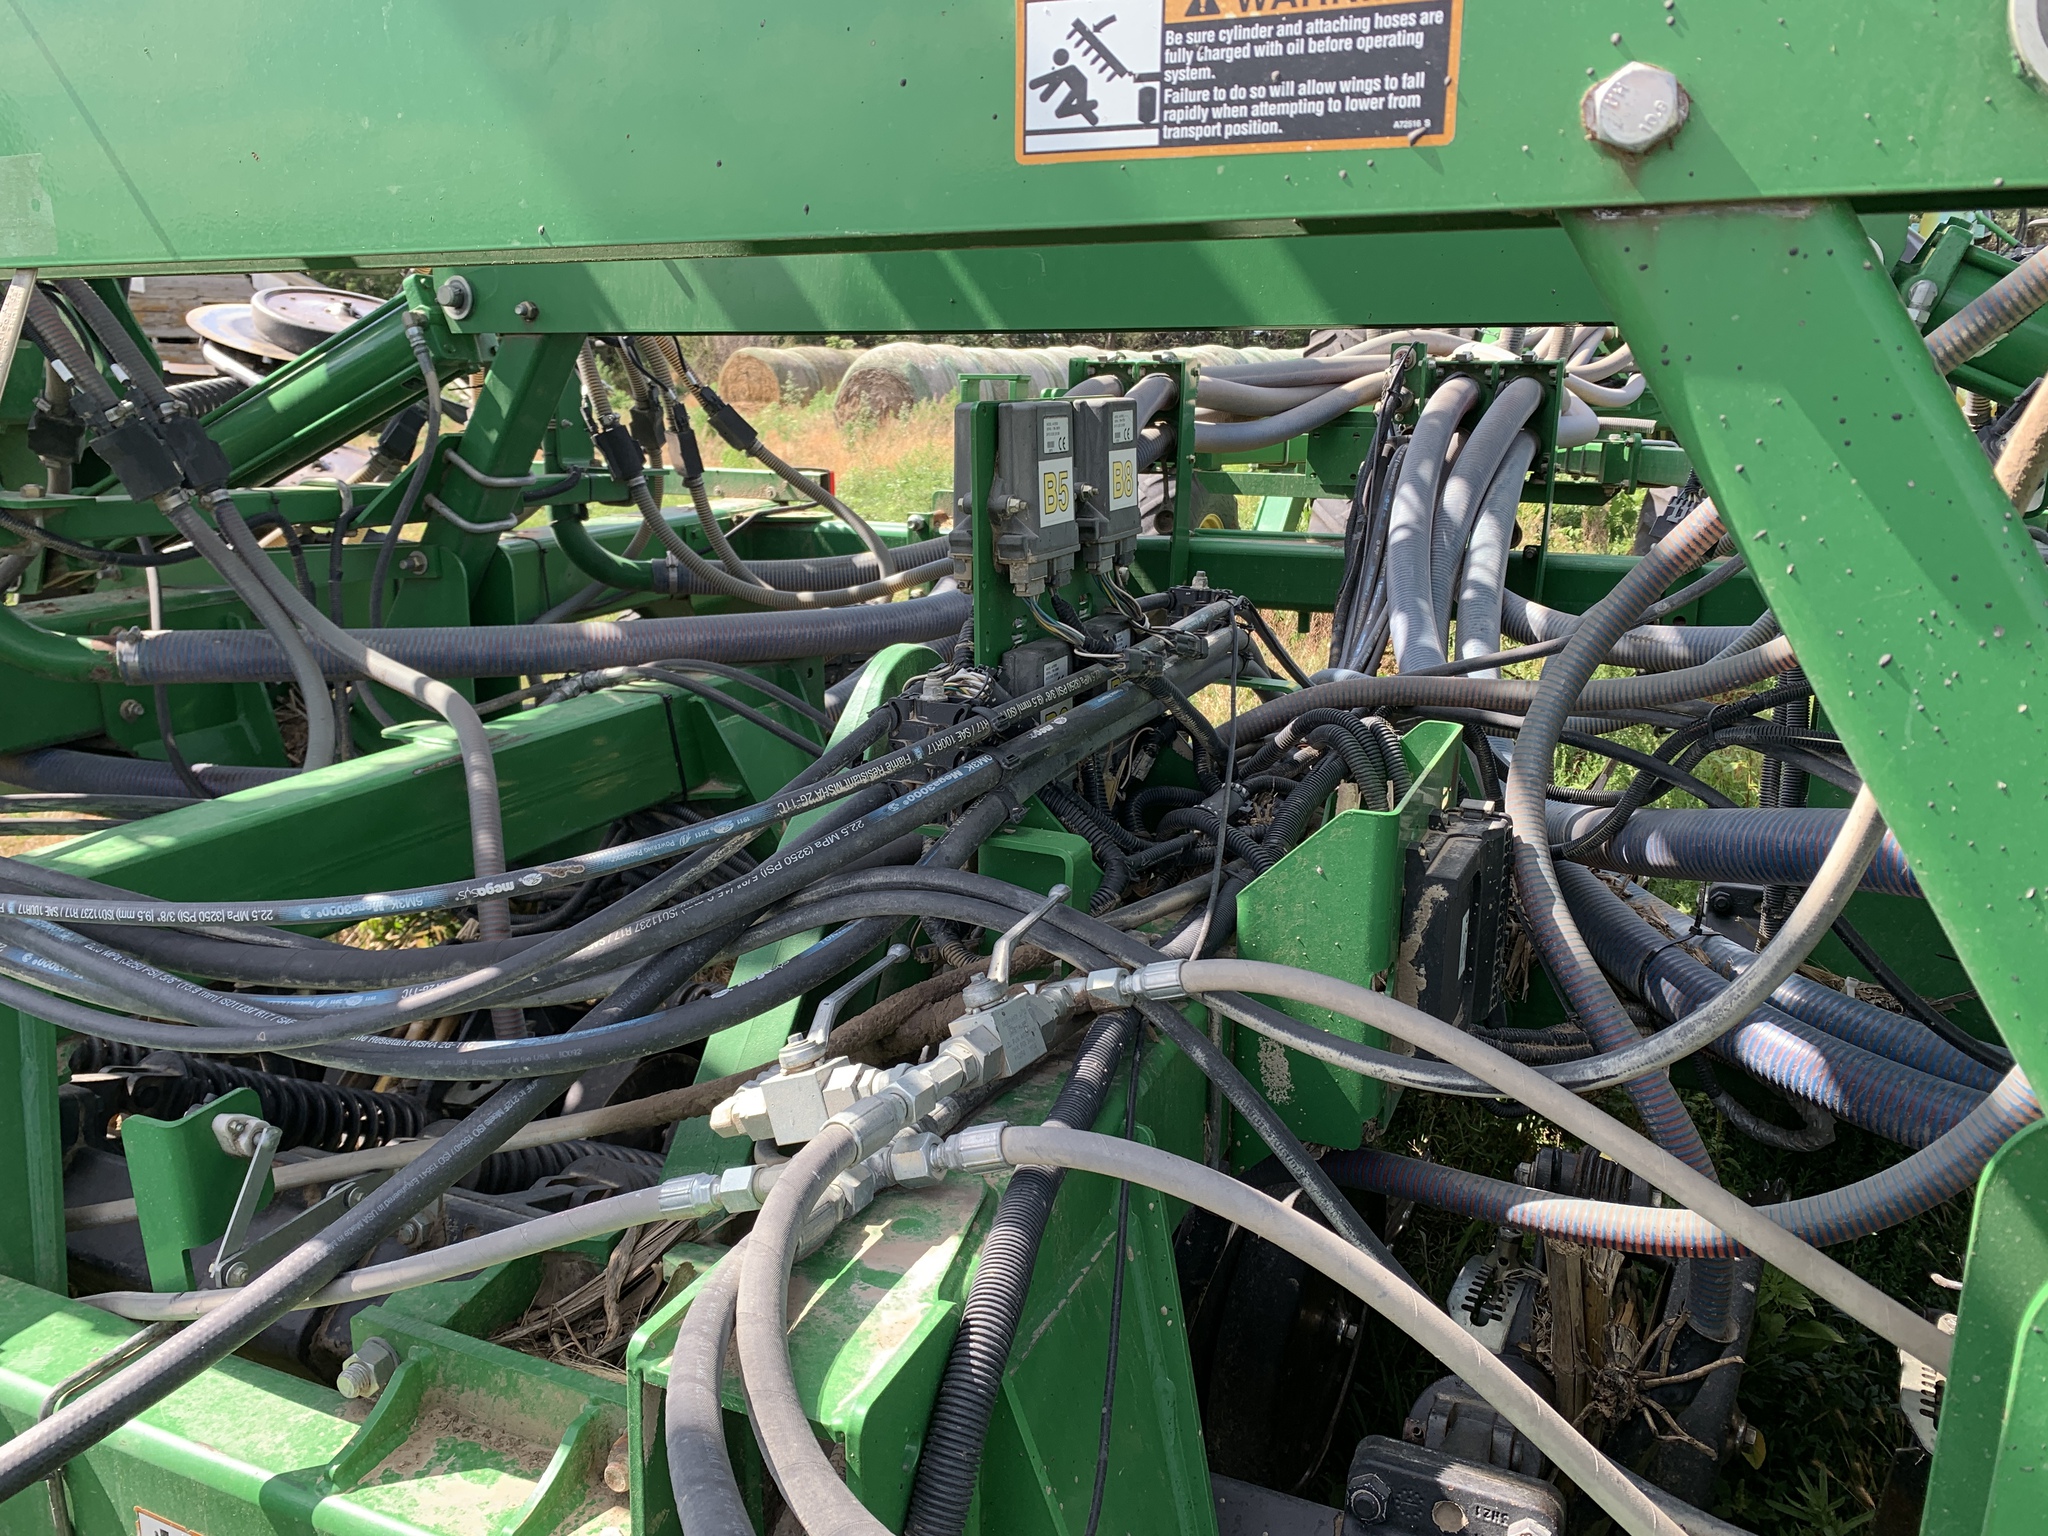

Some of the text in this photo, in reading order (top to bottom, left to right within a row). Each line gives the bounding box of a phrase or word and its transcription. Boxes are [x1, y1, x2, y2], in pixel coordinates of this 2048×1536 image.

[1166, 11, 1444, 46] Be sure cylinder and attaching hoses are
[1165, 31, 1424, 66] fully charged with oil before operating
[1164, 67, 1216, 83] system.
[1164, 73, 1425, 104] Failure to do so will allow wings to fall
[1163, 93, 1421, 124] rapidly when attempting to lower from
[1162, 120, 1283, 141] transport position.
[1112, 459, 1134, 500] B8
[1043, 470, 1070, 514] B5
[955, 726, 971, 744] SAE
[884, 752, 911, 774] Flame
[843, 765, 884, 792] Resistant
[813, 780, 842, 800] MSHA
[776, 792, 813, 816] 2G-11C
[736, 815, 750, 826] 1911
[840, 819, 864, 838] 22.5
[815, 832, 840, 849] MPa
[782, 843, 814, 865] (3250
[759, 858, 782, 877] PSI)
[45, 905, 59, 918] SAE
[116, 907, 136, 921] mm)
[138, 909, 154, 922] (9.5
[177, 909, 197, 923] PSI)
[199, 909, 225, 922] (3250
[227, 910, 249, 922] MPa
[251, 909, 273, 920] 22.5
[614, 924, 632, 941] R17
[362, 1209, 378, 1224] USA
